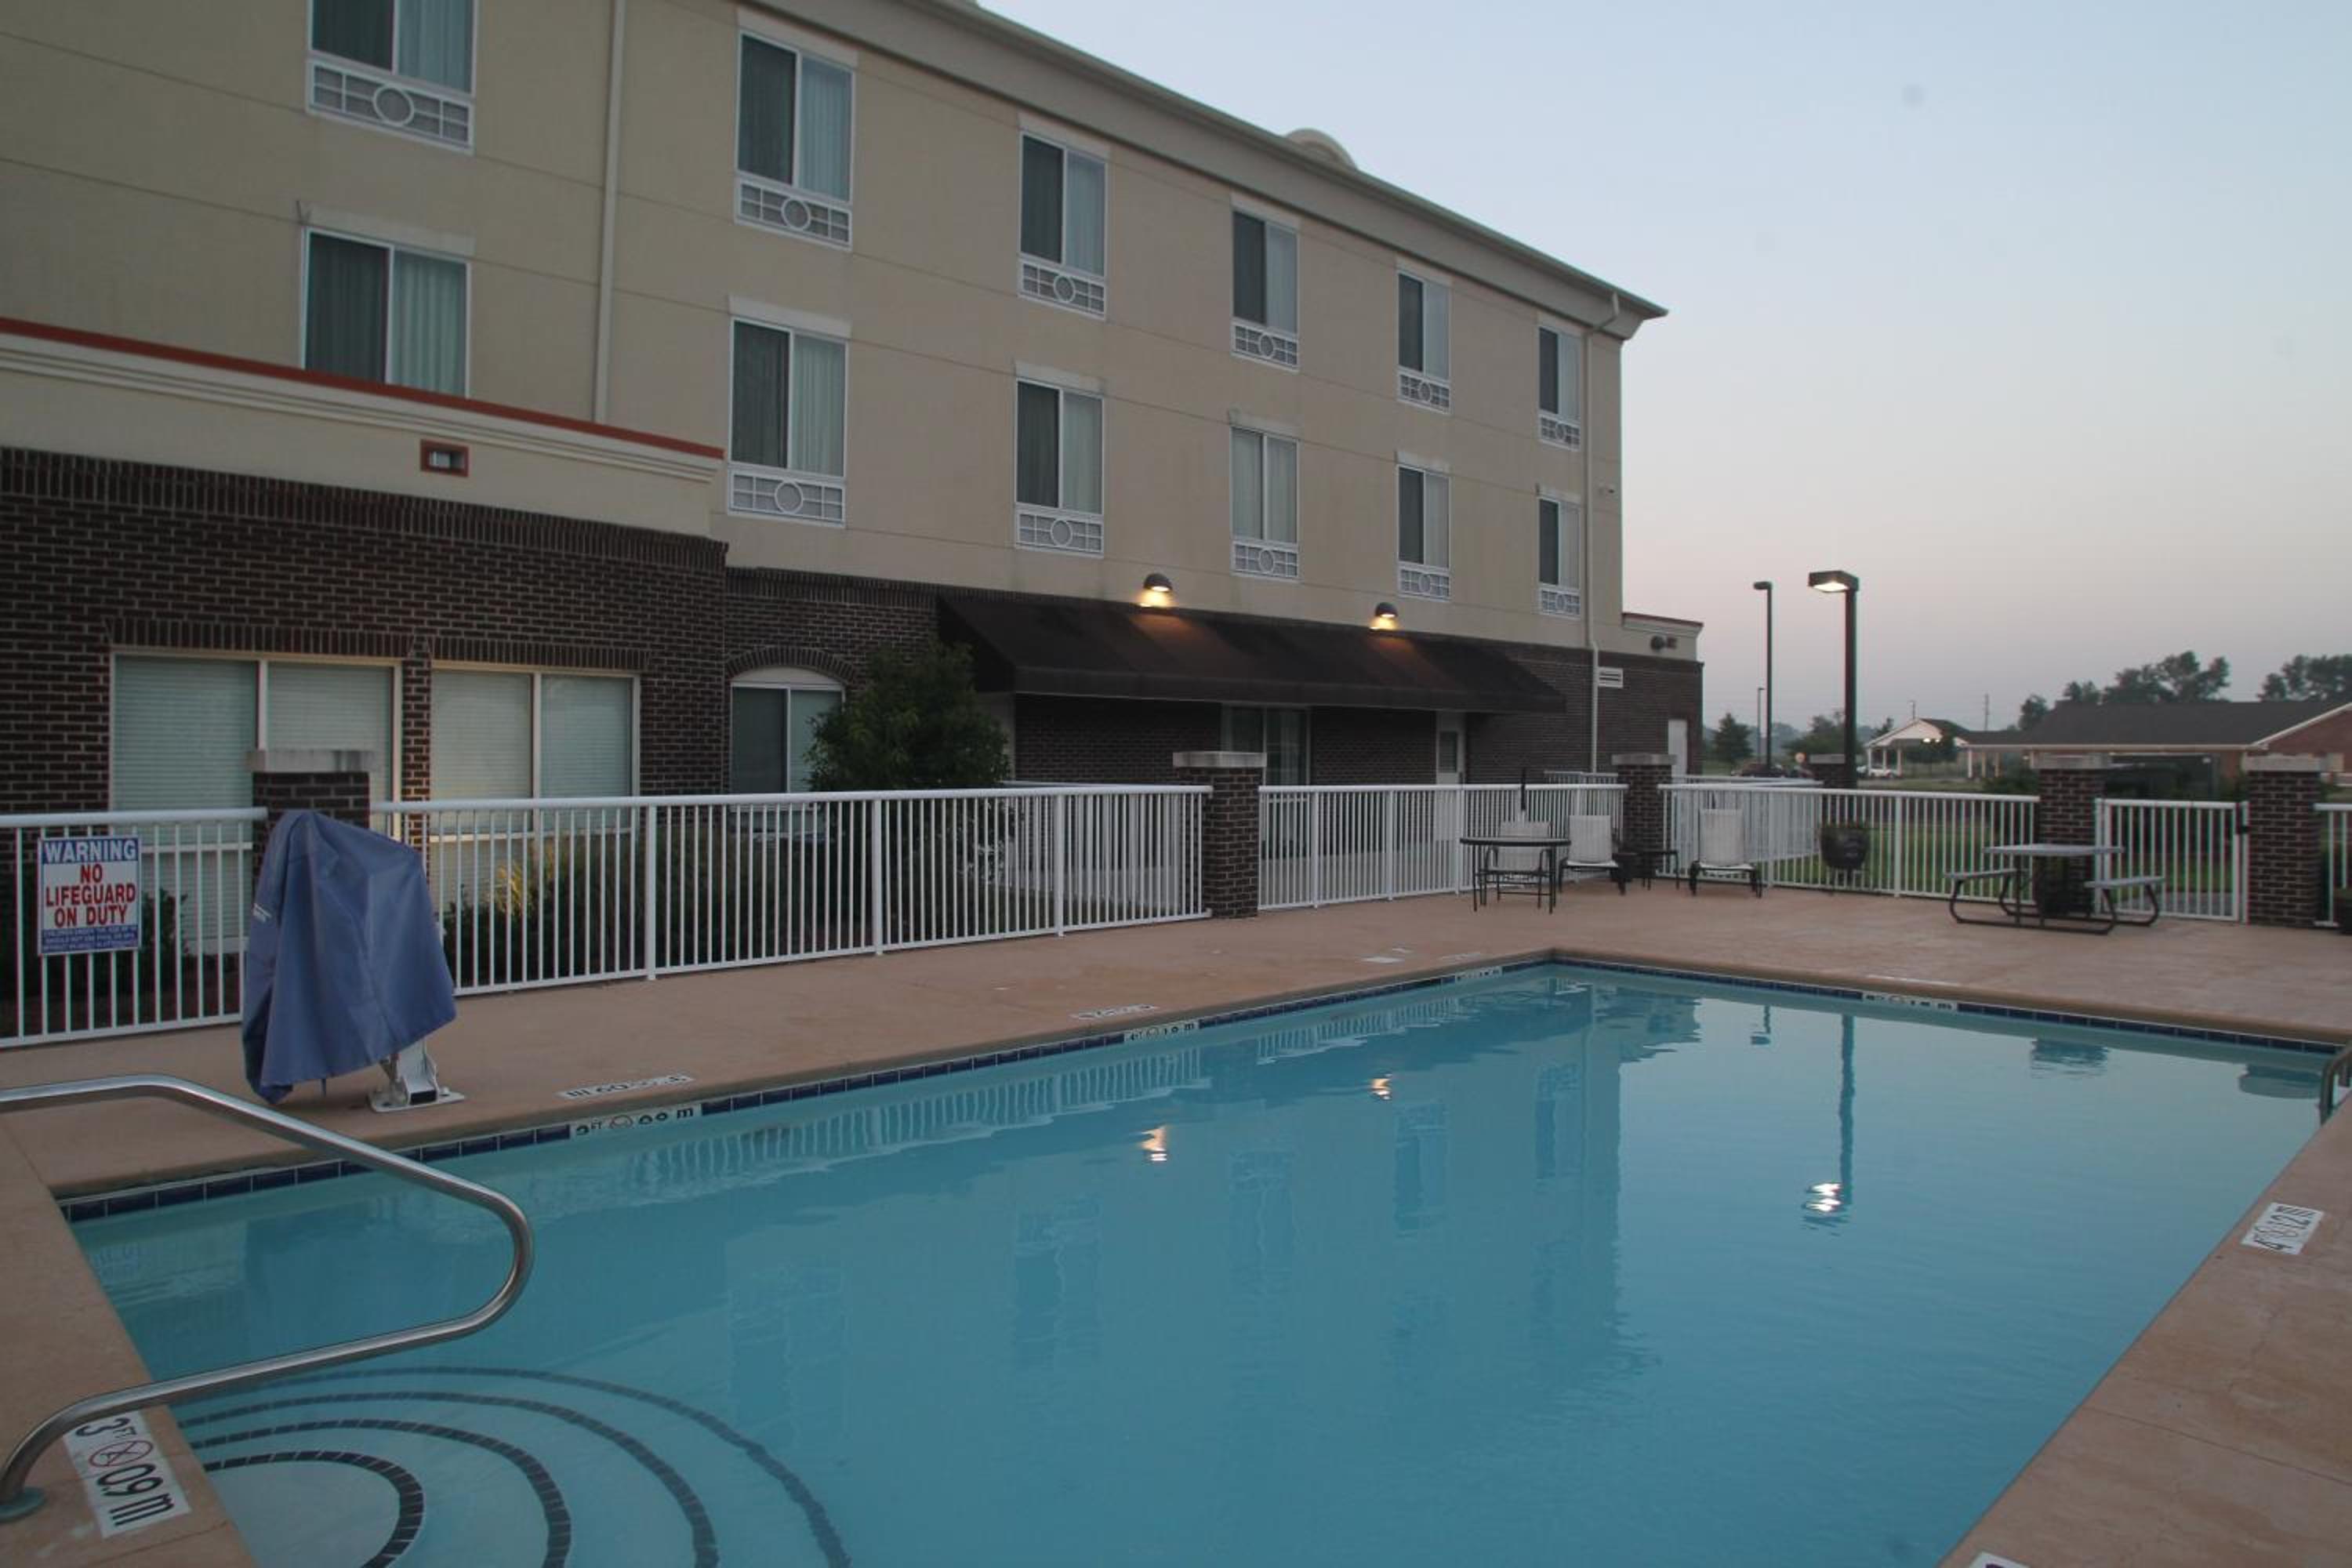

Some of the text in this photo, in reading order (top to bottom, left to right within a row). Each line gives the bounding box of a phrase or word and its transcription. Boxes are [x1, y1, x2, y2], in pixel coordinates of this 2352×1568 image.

[45, 840, 136, 862] WARNING
[81, 864, 103, 883] NO
[45, 884, 136, 906] LIFEGUARD
[54, 906, 127, 927] ON DUTY
[108, 1493, 175, 1526] m
